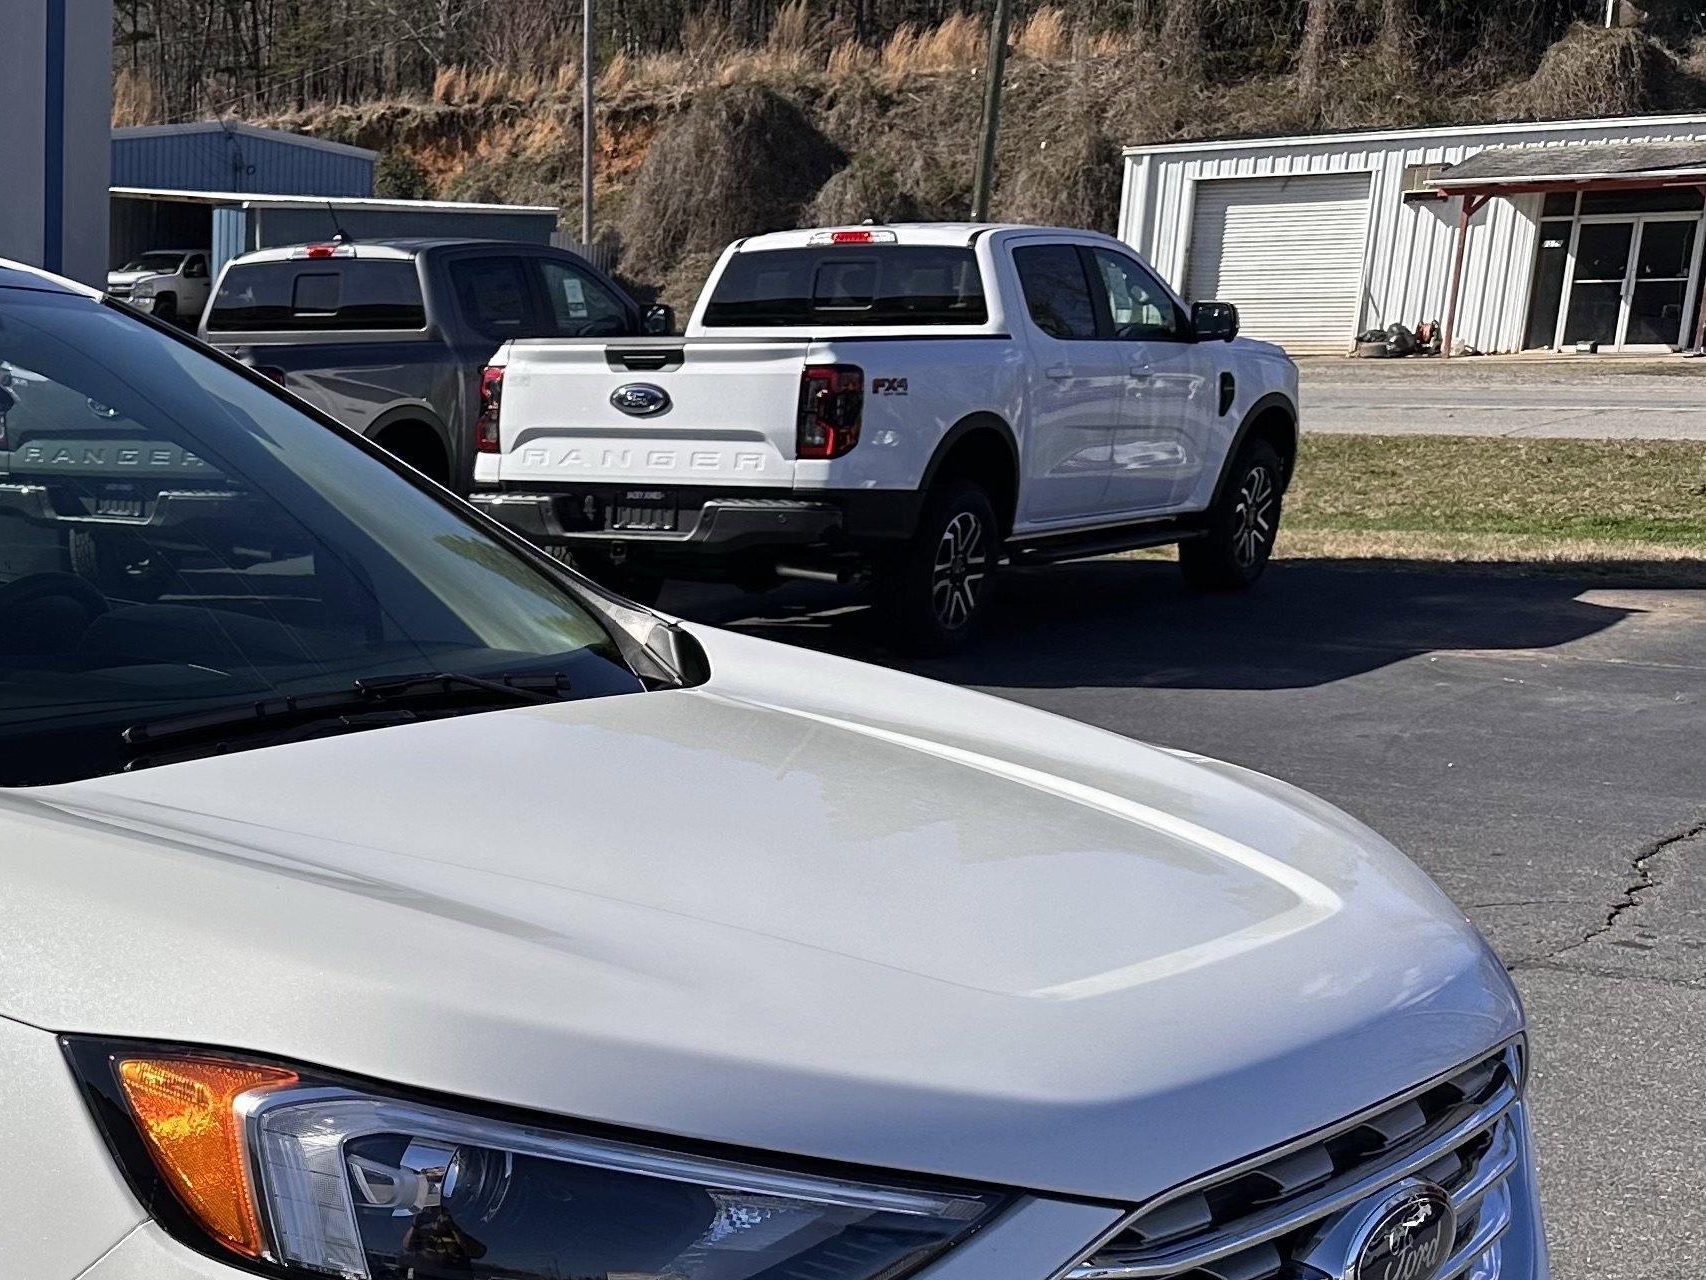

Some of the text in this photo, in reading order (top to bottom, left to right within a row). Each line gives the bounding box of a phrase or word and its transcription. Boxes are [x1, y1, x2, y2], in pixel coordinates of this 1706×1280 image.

[872, 377, 908, 395] FX4
[24, 446, 206, 467] RANGER
[522, 448, 766, 471] RANGER
